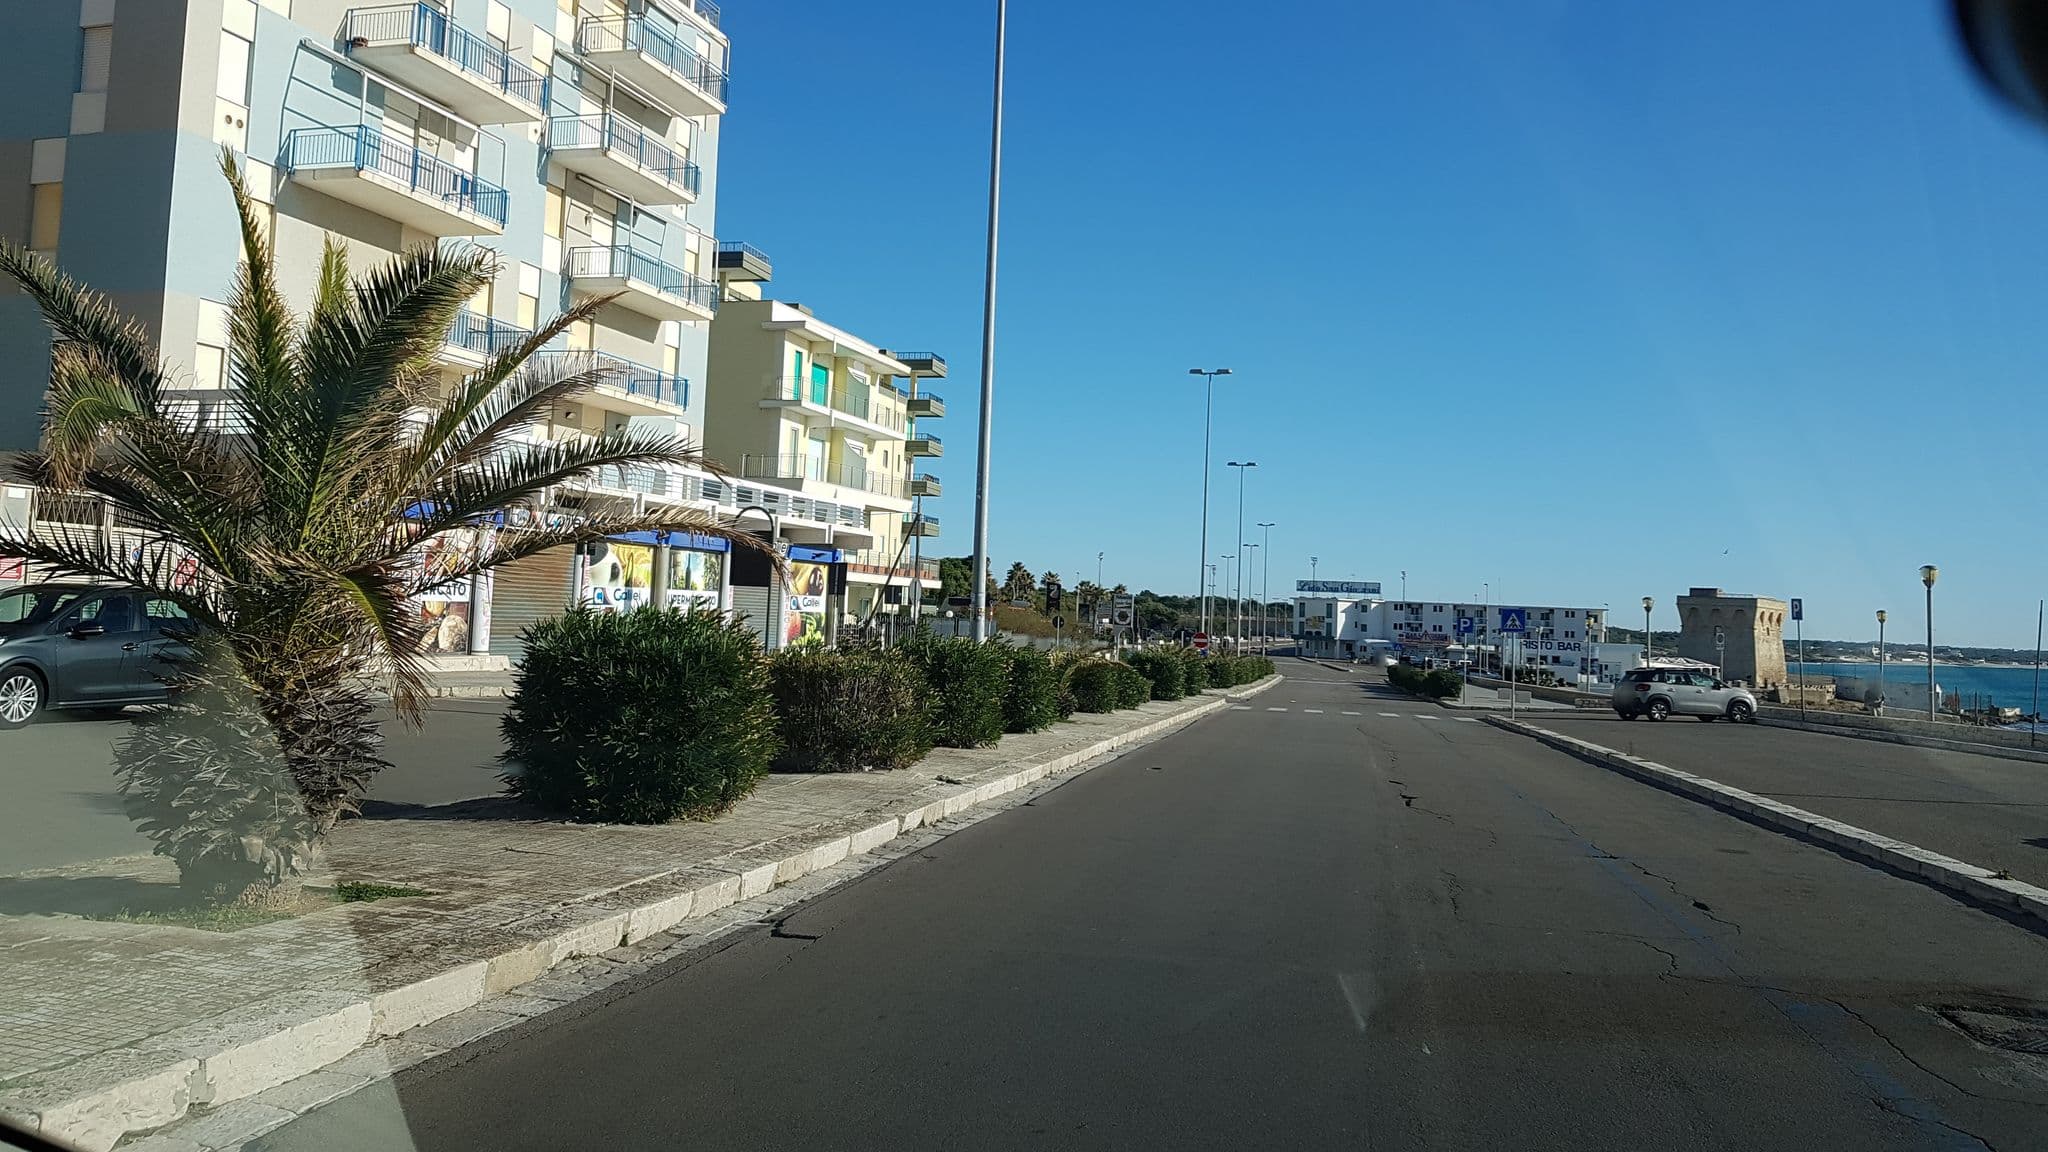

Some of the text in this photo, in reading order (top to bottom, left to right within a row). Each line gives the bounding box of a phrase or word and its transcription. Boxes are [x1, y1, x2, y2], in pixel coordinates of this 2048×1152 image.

[1322, 581, 1340, 592] San
[1793, 601, 1800, 617] P
[1460, 618, 1471, 630] P
[1521, 640, 1582, 652] RISTO BAR
